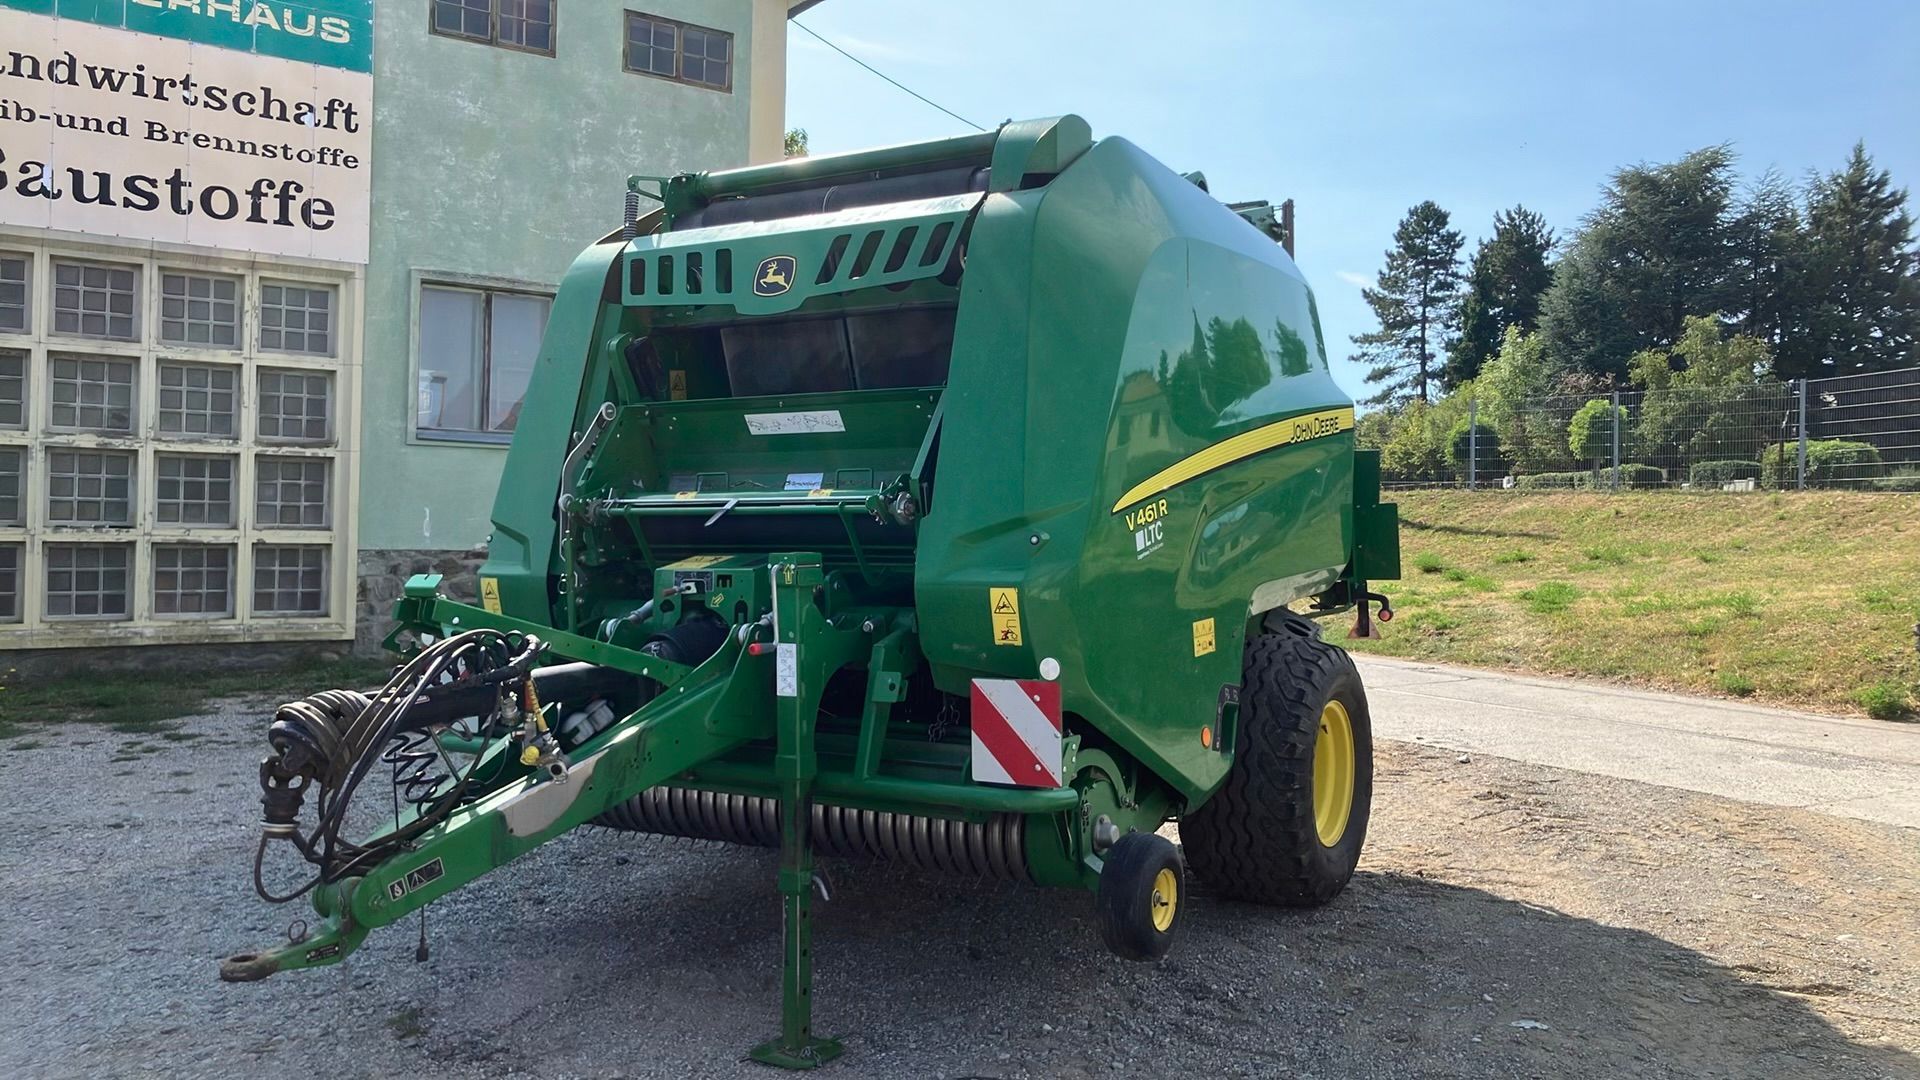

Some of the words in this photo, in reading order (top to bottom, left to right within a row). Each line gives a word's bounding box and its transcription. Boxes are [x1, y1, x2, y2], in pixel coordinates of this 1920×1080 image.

[0, 51, 359, 133] ndwirtschaft
[144, 120, 359, 169] Brennstoffe
[0, 148, 336, 231] austoffe
[1290, 421, 1313, 442] JOHN
[1314, 416, 1340, 436] DEERE
[1125, 512, 1135, 531] V
[1136, 502, 1158, 526] 461
[1158, 498, 1168, 517] R
[1144, 520, 1164, 547] LTC
